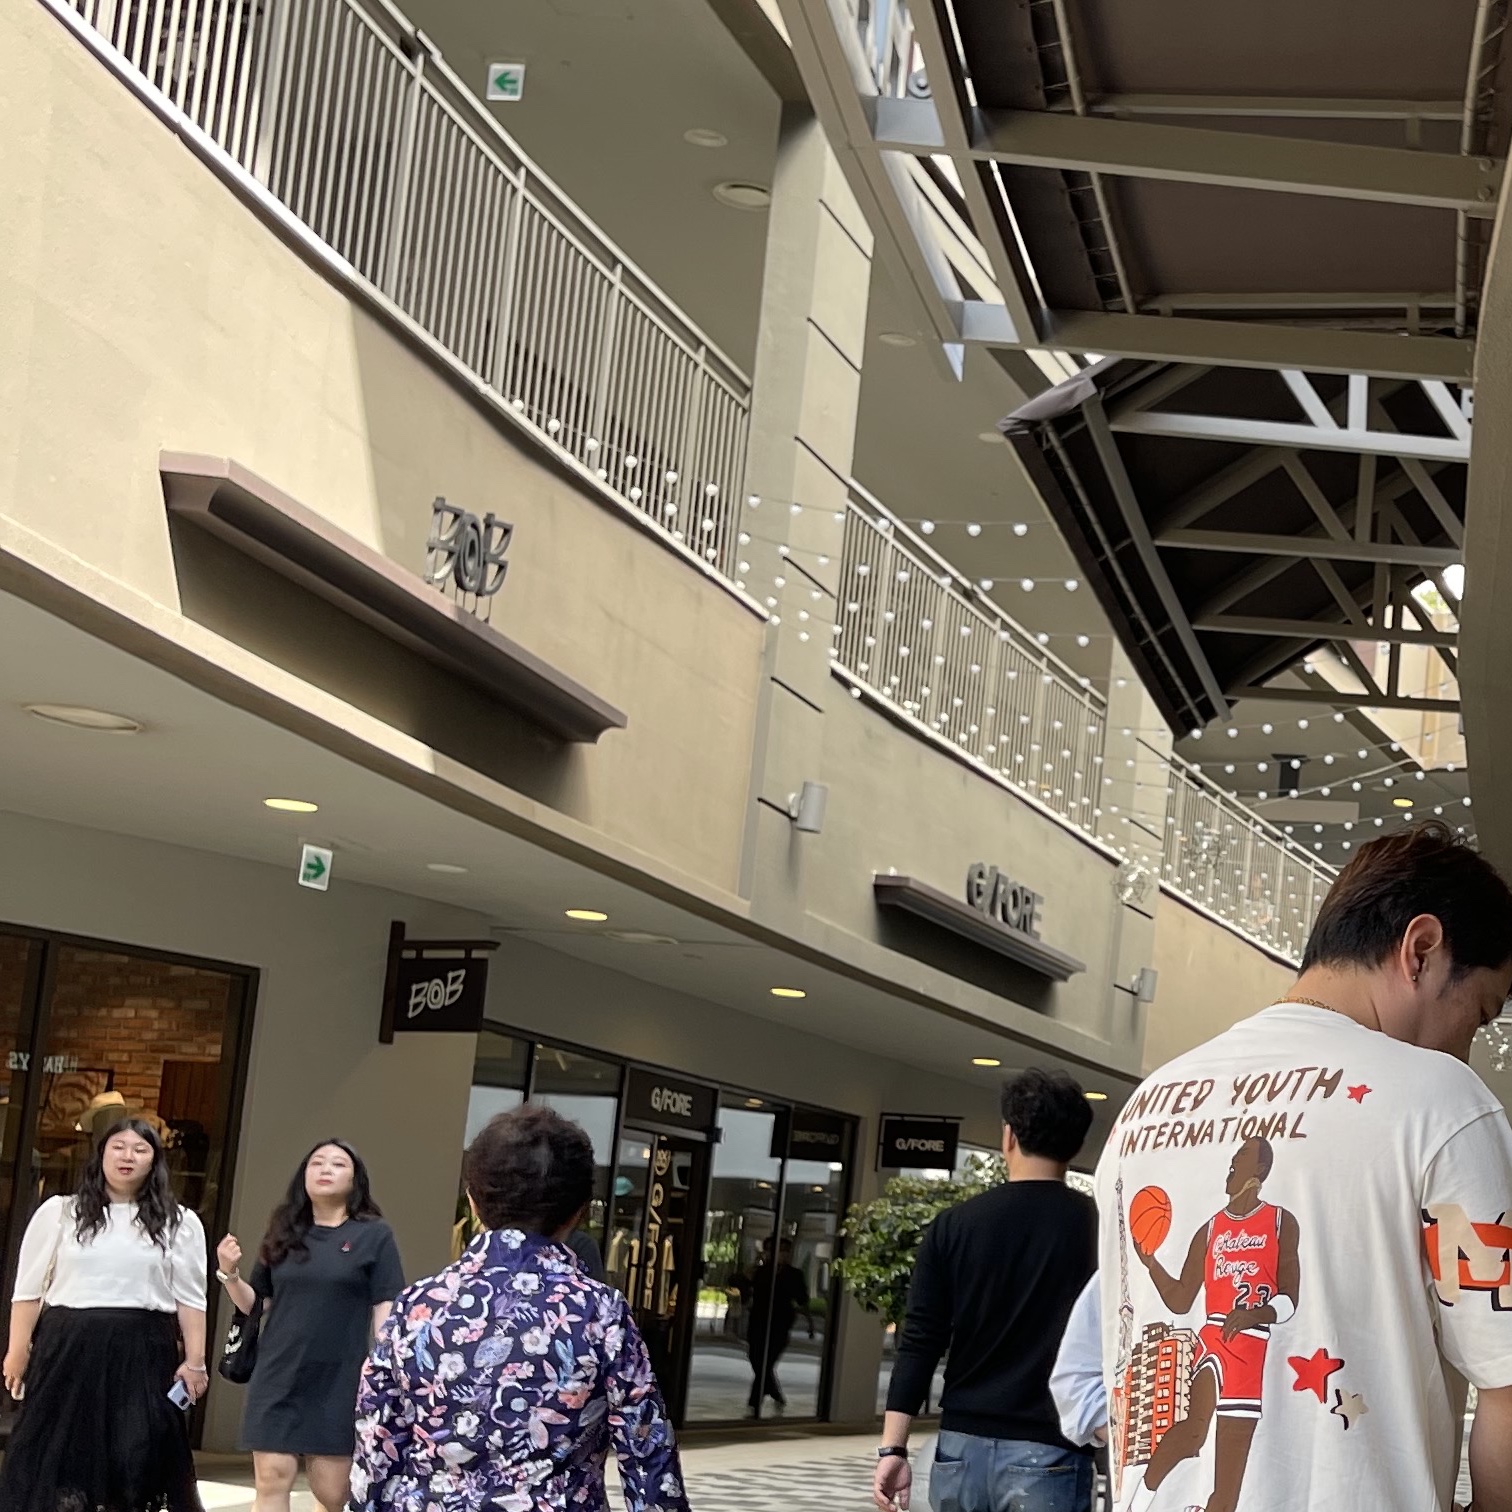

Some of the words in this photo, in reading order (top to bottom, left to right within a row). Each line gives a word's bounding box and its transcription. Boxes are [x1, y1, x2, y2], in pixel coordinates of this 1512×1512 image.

[407, 968, 466, 1019] BOB
[1121, 1078, 1216, 1125] UNITED
[1231, 1066, 1344, 1107] YOUTH
[895, 1137, 946, 1153] G/FORE
